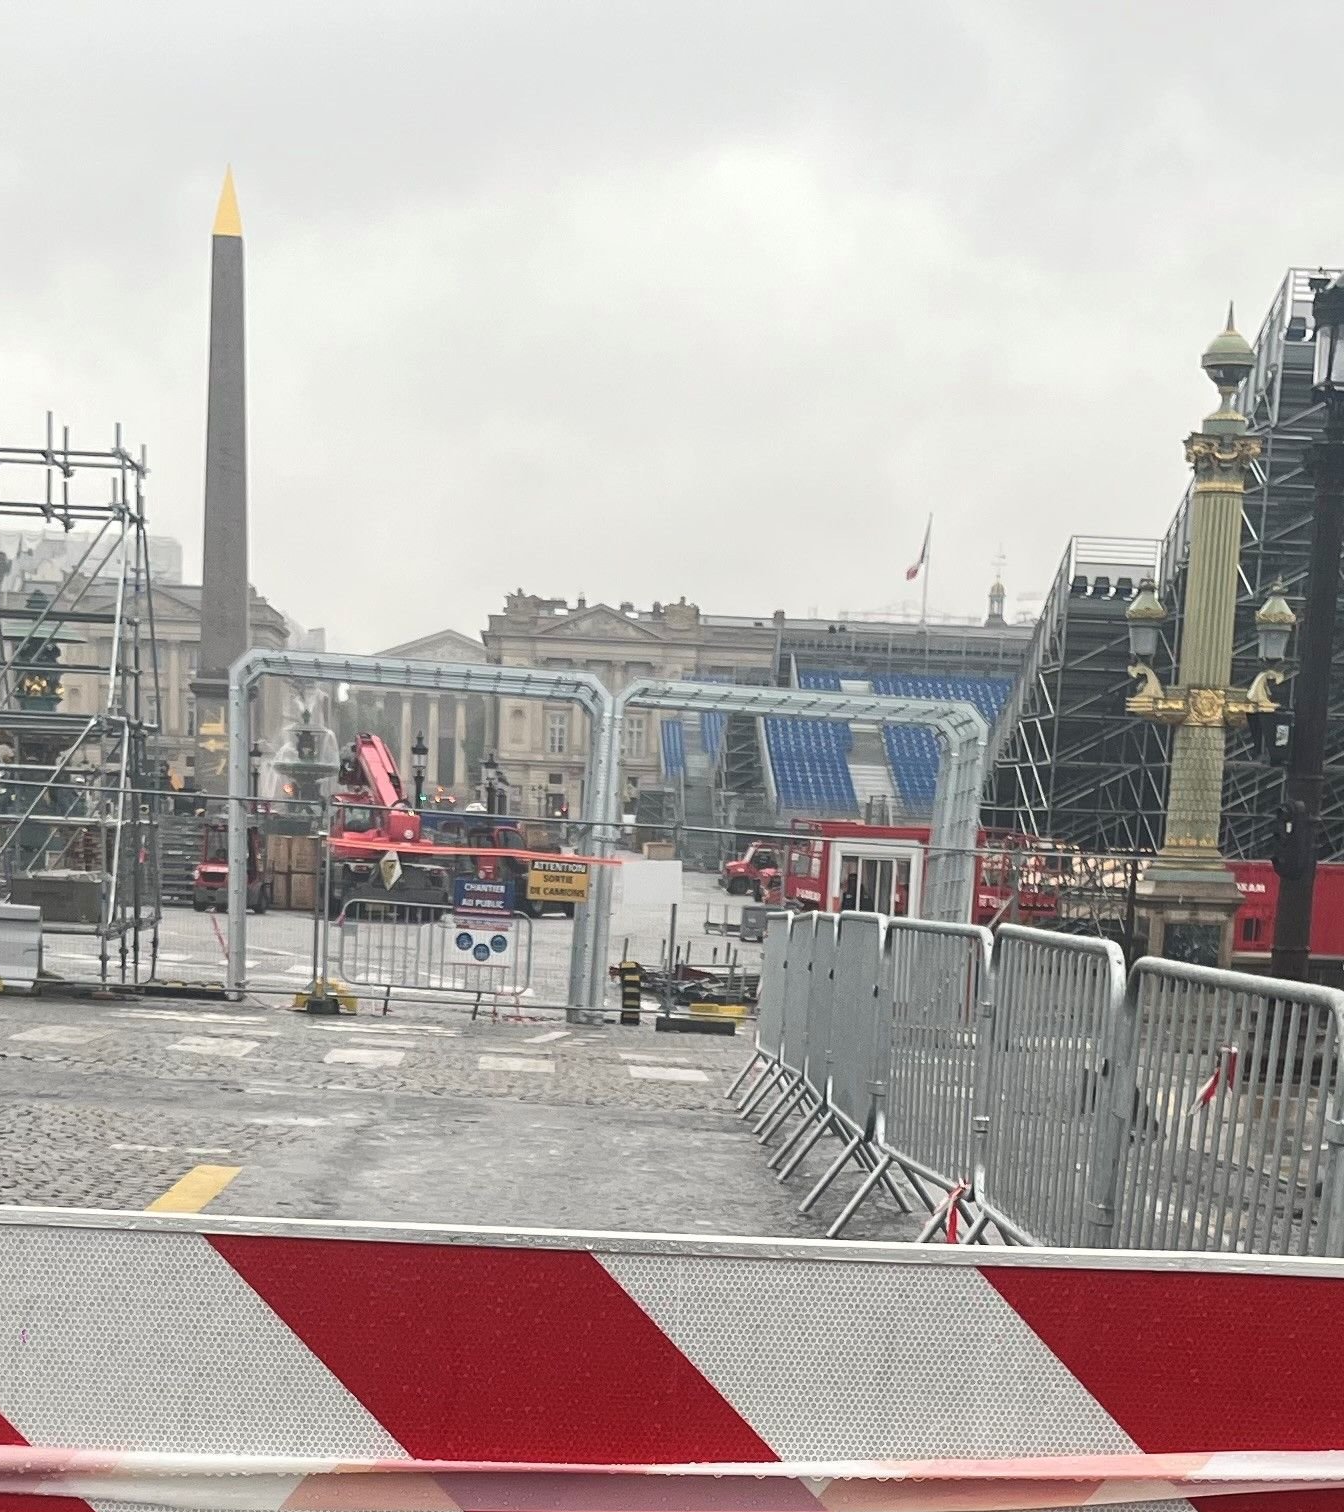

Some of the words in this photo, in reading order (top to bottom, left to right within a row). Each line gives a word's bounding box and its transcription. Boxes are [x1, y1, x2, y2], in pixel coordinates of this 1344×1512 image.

[543, 874, 573, 884] SORTIE
[464, 882, 506, 893] CHANTIER
[530, 887, 540, 896] DE
[543, 887, 585, 898] CAMIONS
[475, 899, 505, 909] PUBLIC
